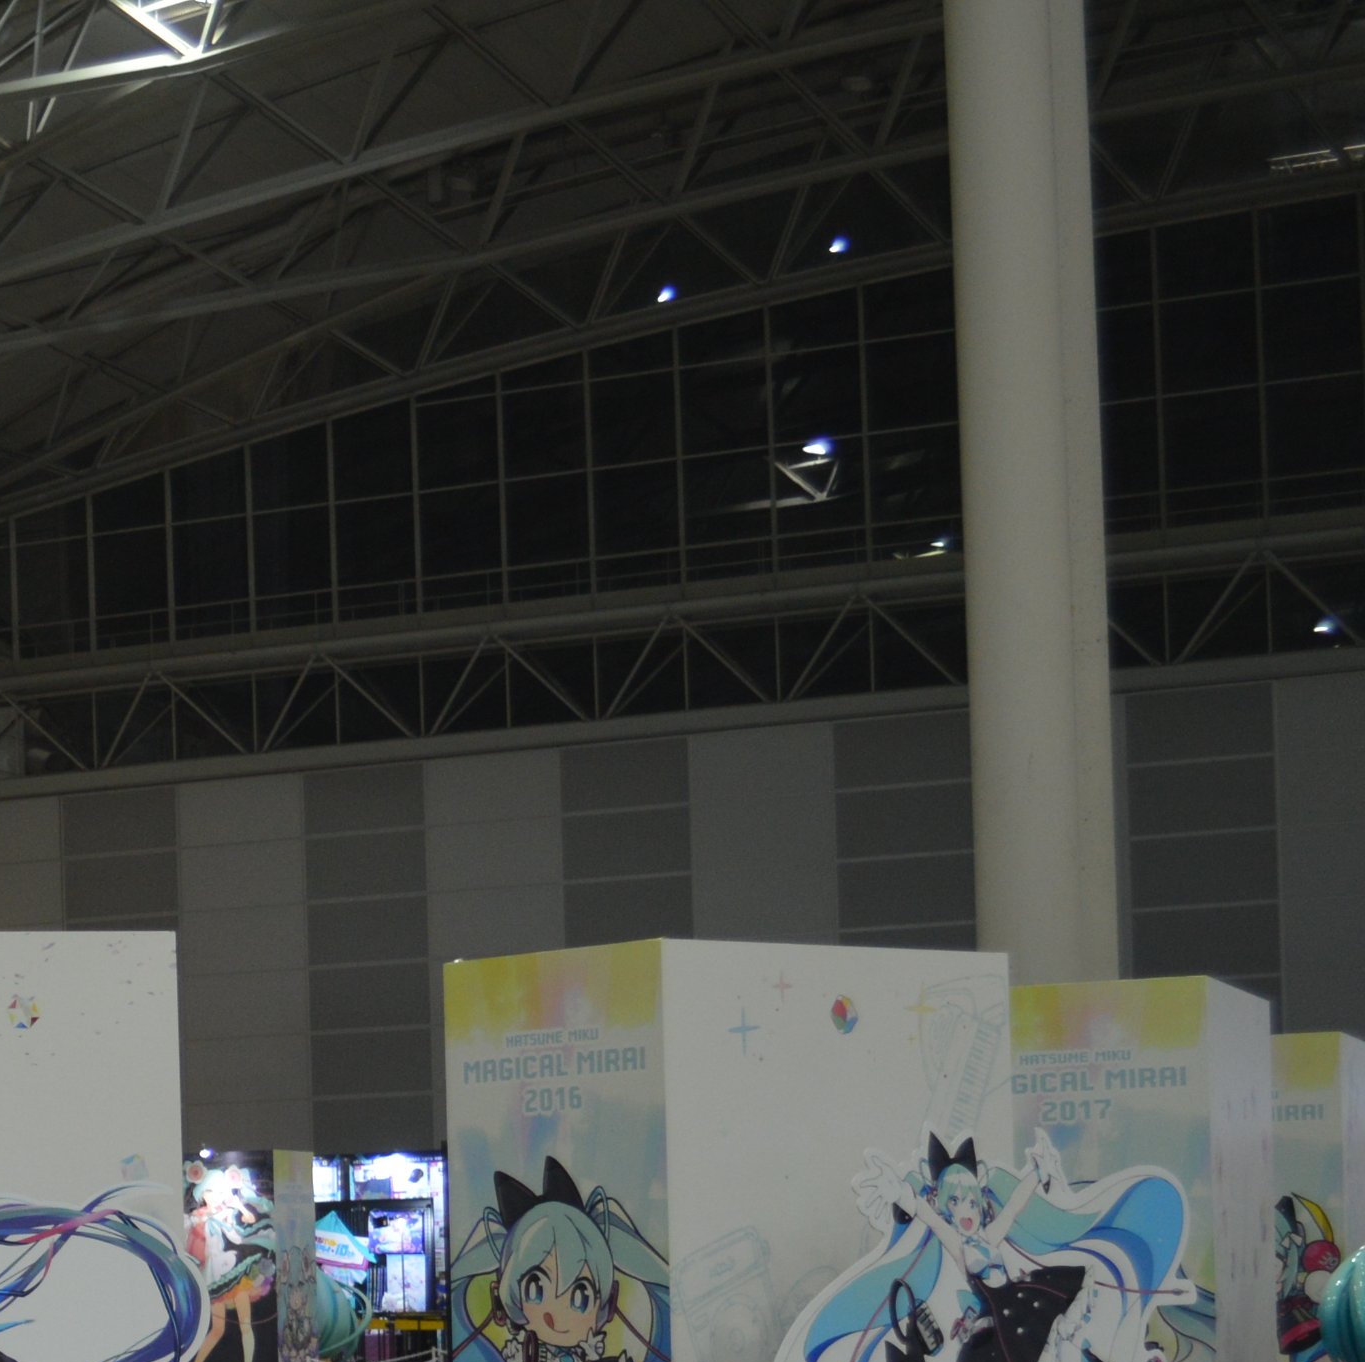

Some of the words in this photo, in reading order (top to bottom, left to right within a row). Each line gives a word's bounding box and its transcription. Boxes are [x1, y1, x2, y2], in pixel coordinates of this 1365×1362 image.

[505, 1030, 563, 1049] HATSUNE
[568, 1027, 599, 1043] MIKU
[463, 1054, 568, 1085] MAGICAL
[576, 1045, 646, 1075] MIRAI
[1019, 1051, 1089, 1067] HATSUNE
[1094, 1049, 1131, 1062] MIKU
[1012, 1071, 1094, 1094] GICAL
[1105, 1066, 1187, 1090] MIRAI
[524, 1086, 582, 1113] 2016
[1042, 1099, 1112, 1122] 2017
[1272, 1103, 1324, 1122] IRAI
